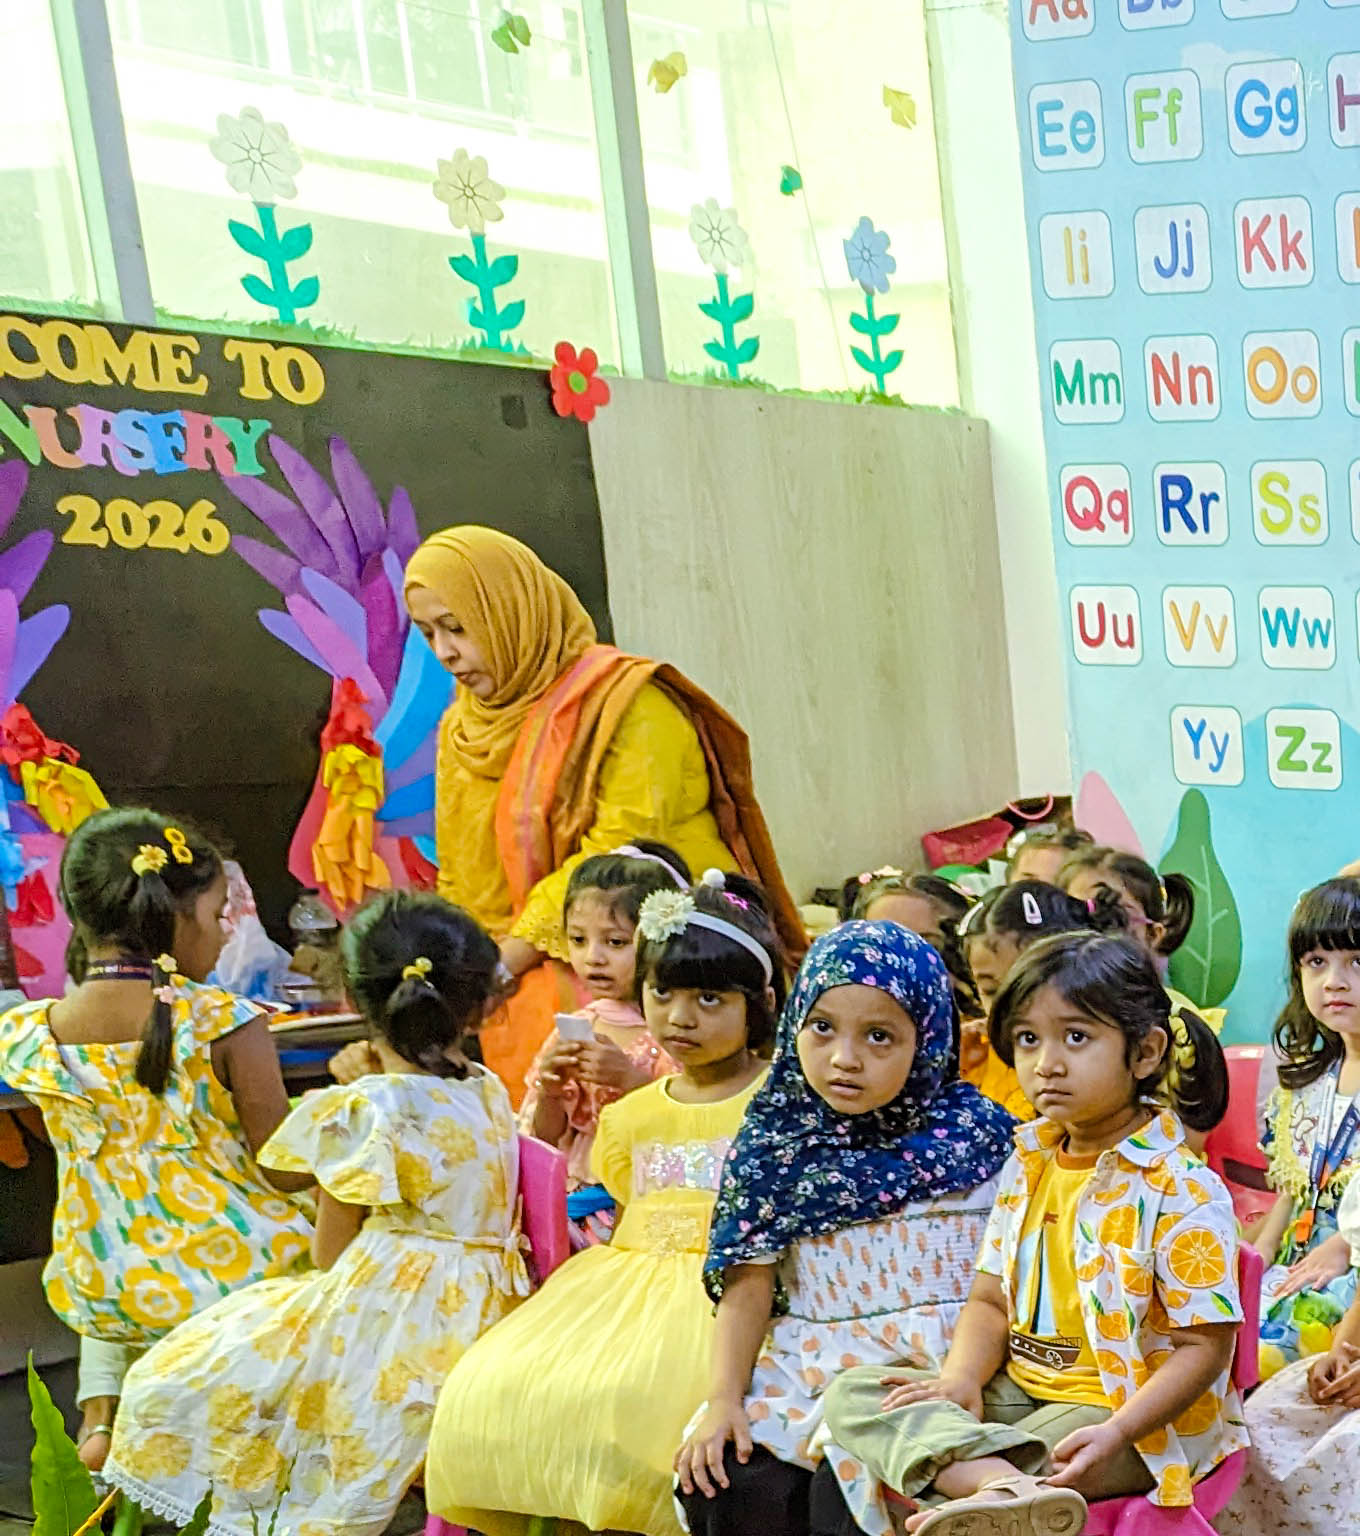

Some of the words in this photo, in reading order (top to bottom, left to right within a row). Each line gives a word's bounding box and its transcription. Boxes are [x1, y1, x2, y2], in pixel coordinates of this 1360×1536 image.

[1036, 100, 1096, 156] Ee
[1133, 88, 1182, 148] Ff
[1234, 79, 1300, 138] Gg
[1064, 226, 1090, 286] Ii
[1154, 219, 1195, 279] Jj
[1242, 213, 1307, 273] Kk
[224, 339, 326, 405] TO
[1054, 358, 1122, 406] Mm
[1151, 351, 1215, 406] Nn
[1247, 346, 1318, 405] Oo
[56, 494, 232, 555] 2026
[1064, 475, 1129, 535] Qq
[1160, 473, 1220, 535] Rr
[1258, 471, 1322, 535] Ss
[1077, 601, 1135, 649] Uu
[1169, 600, 1228, 652] Vv
[1262, 606, 1332, 649] Ww
[1183, 717, 1230, 773] Yy
[1275, 725, 1334, 773] Zz
